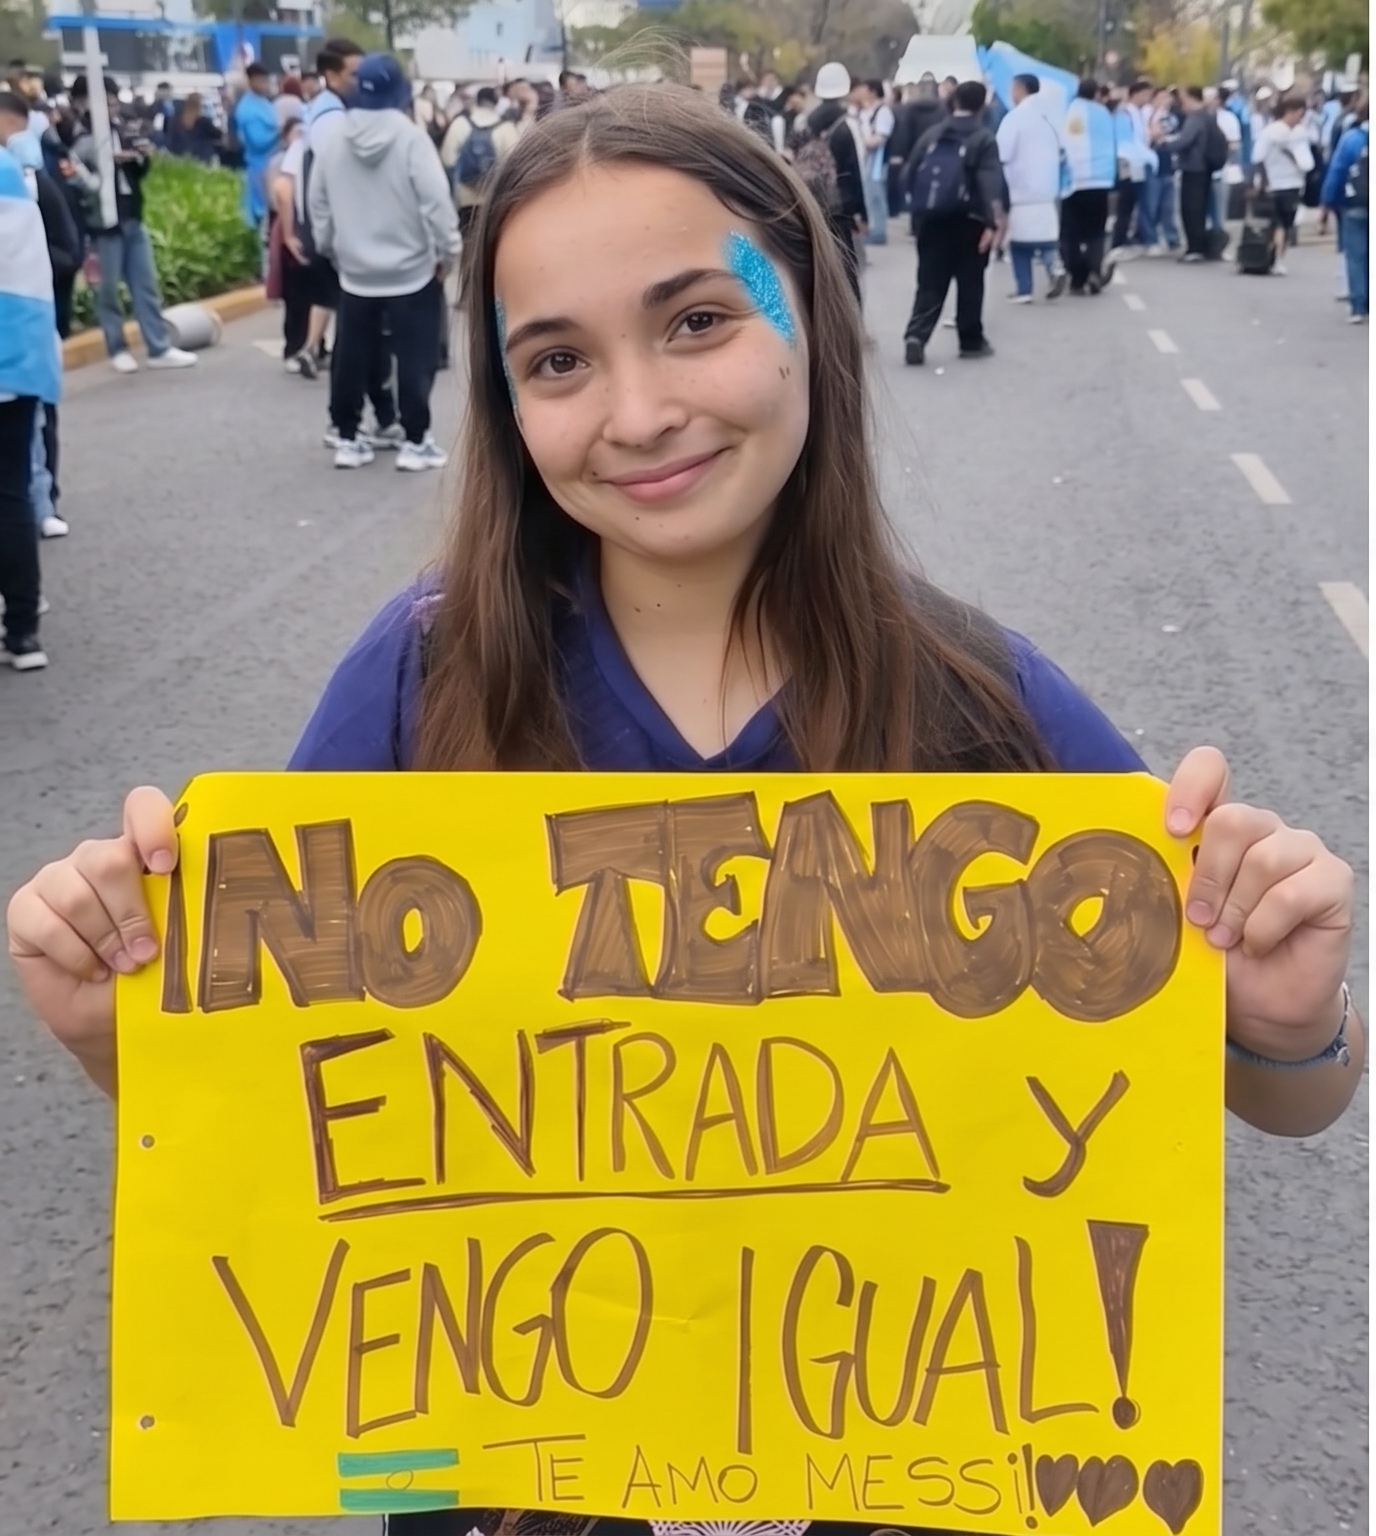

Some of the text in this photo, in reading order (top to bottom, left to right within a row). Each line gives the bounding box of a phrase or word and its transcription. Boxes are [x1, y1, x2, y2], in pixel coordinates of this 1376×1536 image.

[545, 790, 1184, 1022] TENGO
[300, 1019, 942, 1206] ENTRADA
[212, 1219, 1149, 1455] VENGO IGUAL!
[483, 1434, 586, 1502] TE
[622, 1445, 758, 1509] AMO
